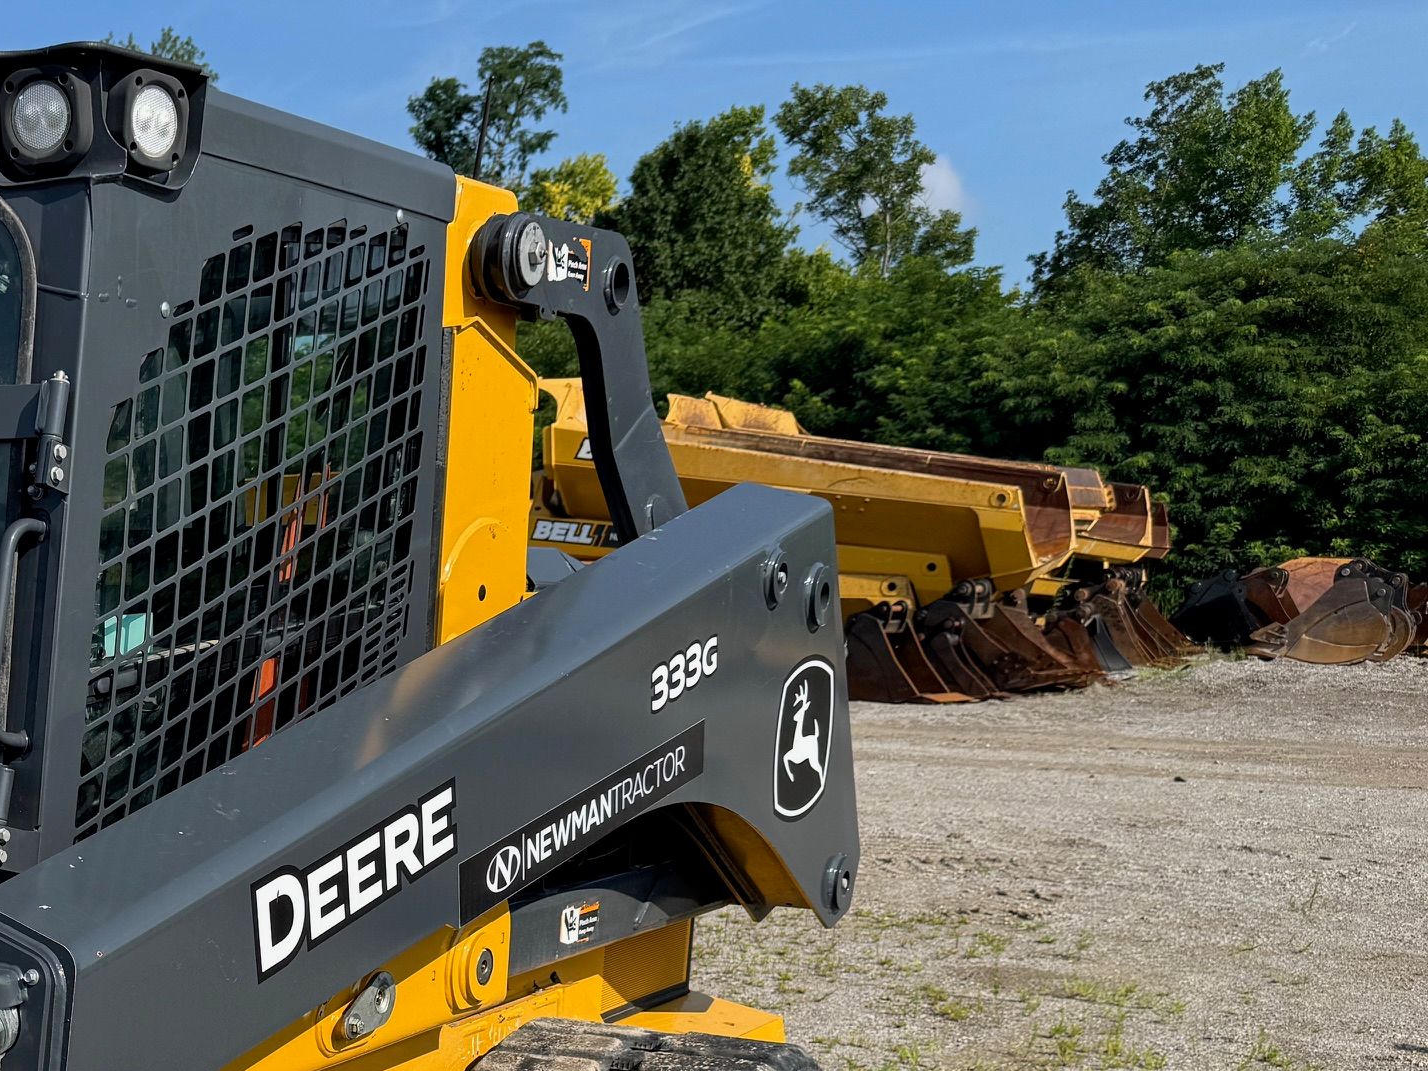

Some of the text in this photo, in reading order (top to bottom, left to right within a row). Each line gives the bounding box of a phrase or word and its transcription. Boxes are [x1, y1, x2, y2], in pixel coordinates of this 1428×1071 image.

[531, 519, 594, 546] BELL
[650, 635, 719, 712] 333G
[255, 786, 455, 974] DEERE
